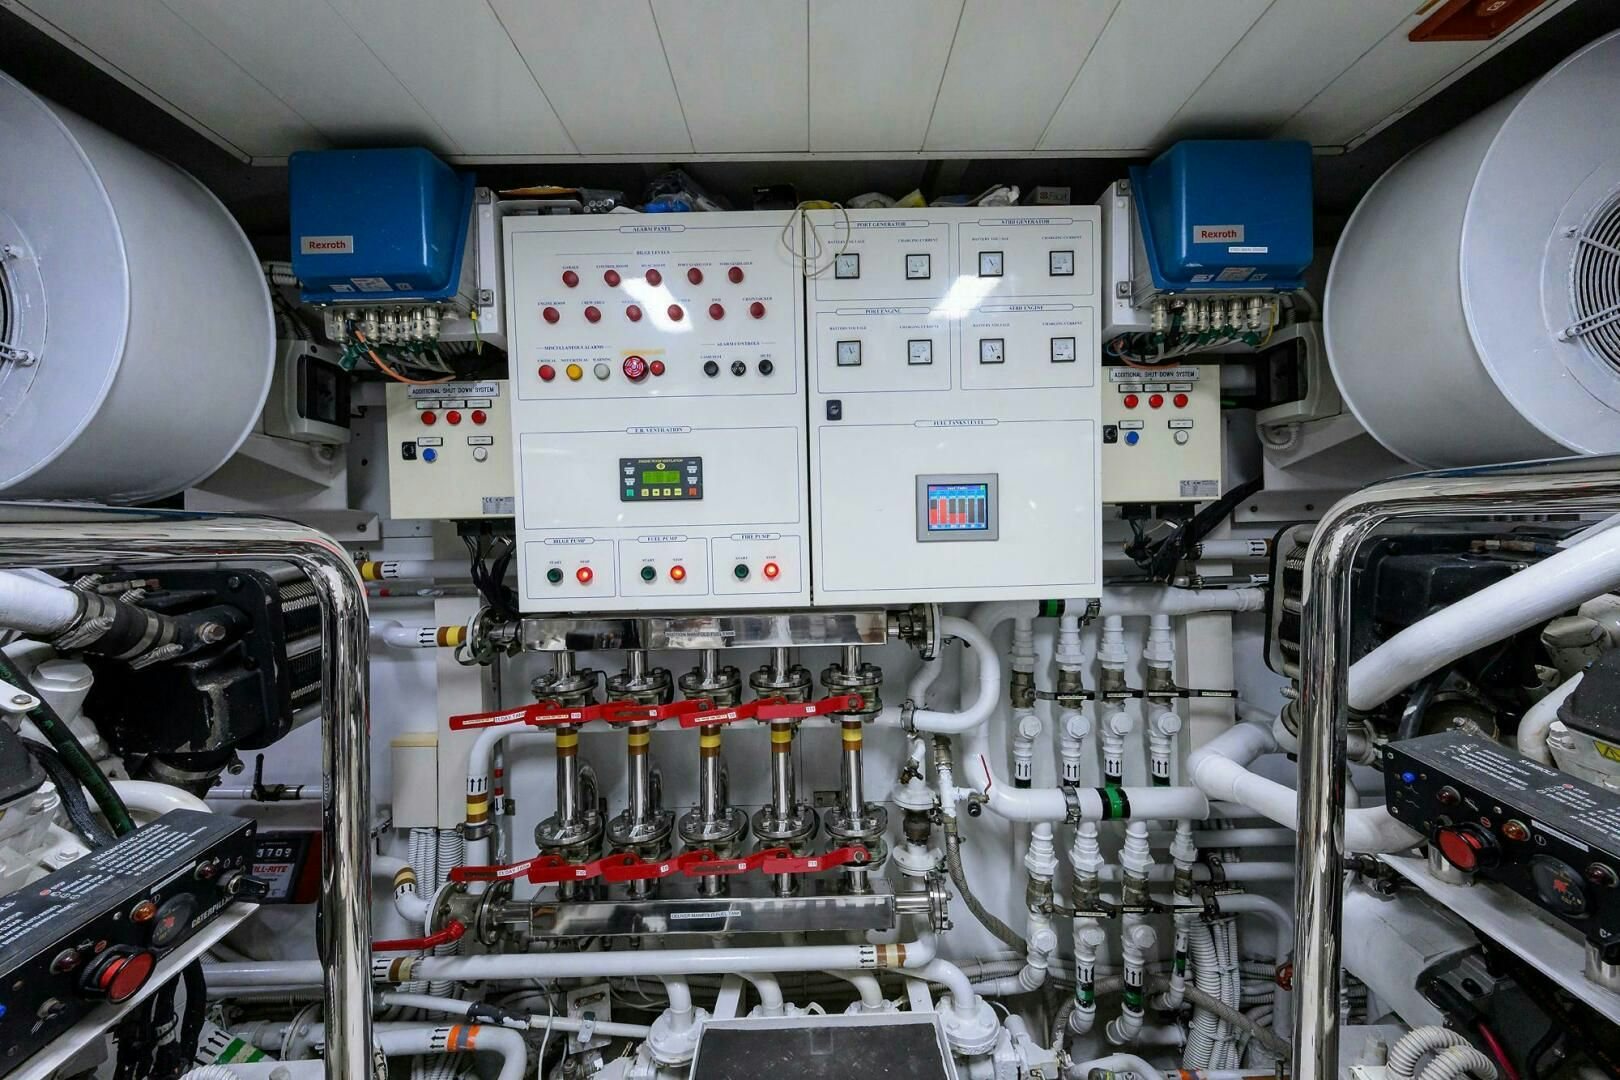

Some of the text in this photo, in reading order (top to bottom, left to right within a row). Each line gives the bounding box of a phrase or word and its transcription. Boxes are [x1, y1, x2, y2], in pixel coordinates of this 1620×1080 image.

[1201, 230, 1237, 238] Rexroth
[309, 241, 346, 249] Rexroth
[1518, 759, 1557, 776] SYMBOLS
[91, 837, 138, 860] DIAGNOSTIC
[136, 824, 162, 836] CODES
